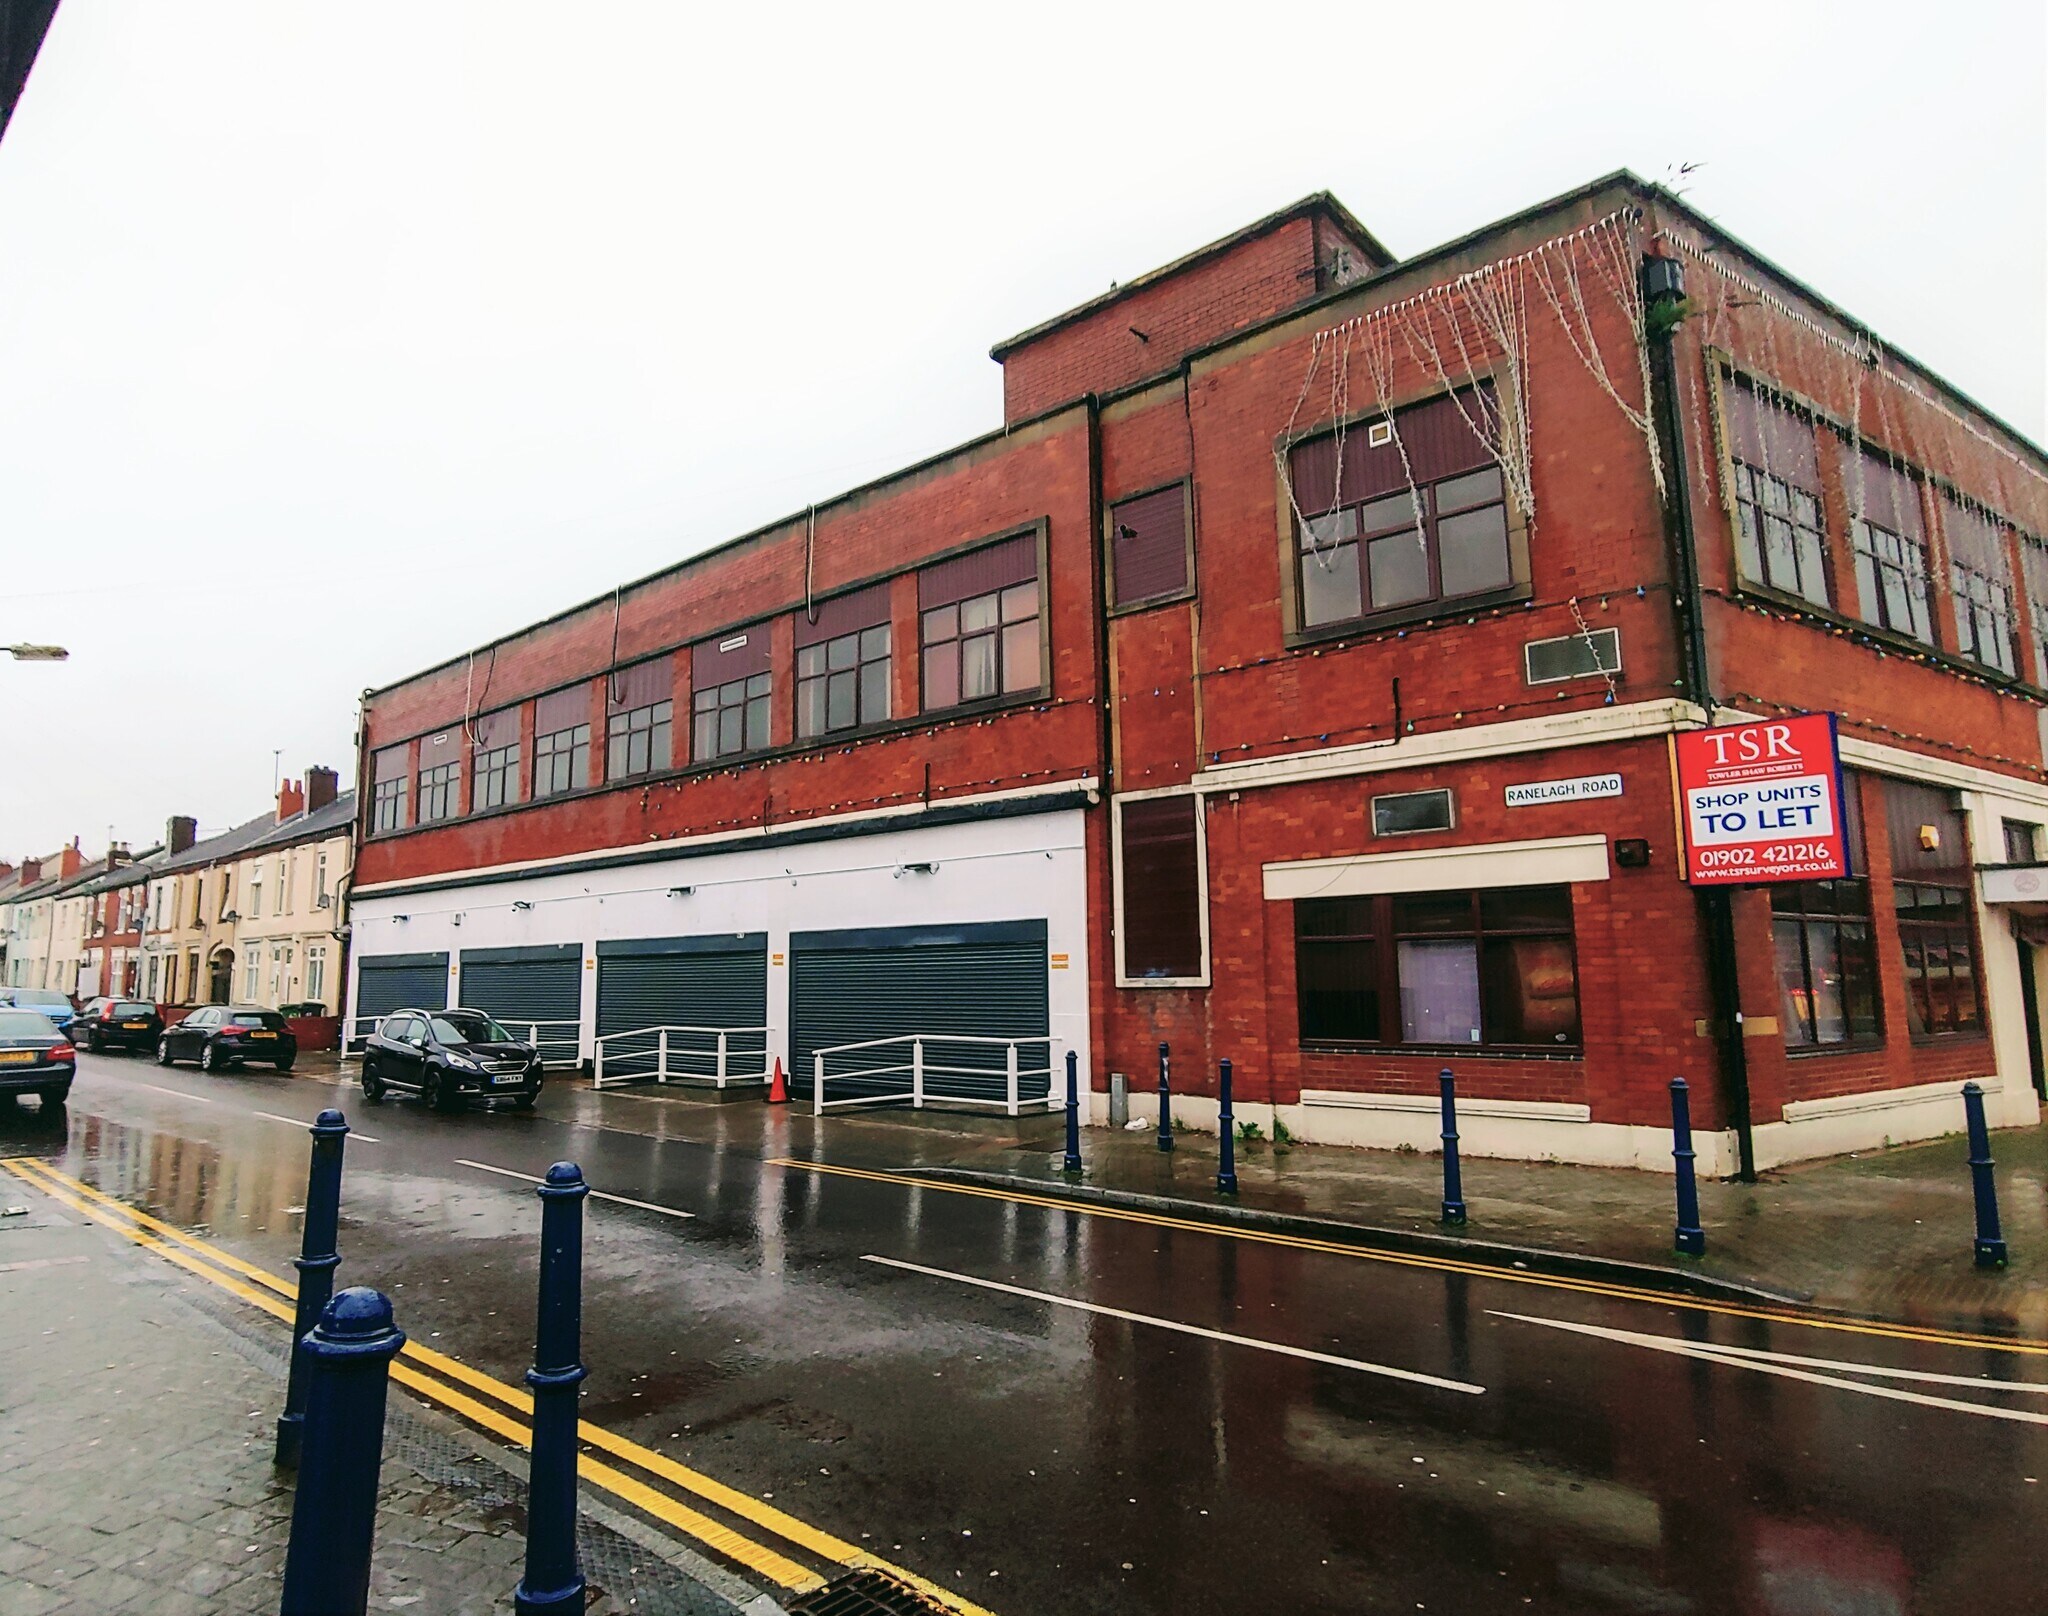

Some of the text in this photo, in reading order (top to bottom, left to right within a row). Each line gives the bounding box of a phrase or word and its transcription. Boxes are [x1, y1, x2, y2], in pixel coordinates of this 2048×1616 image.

[1704, 725, 1801, 764] TSR
[1708, 763, 1804, 781] TOWLER SHAW ROBERTS
[1508, 779, 1619, 801] RANELAGH ROAD
[1696, 785, 1821, 809] SHOP UNITS
[1700, 805, 1820, 833] TO LET
[1700, 842, 1830, 867] 01902 421216
[1695, 859, 1838, 878] www.tsrsurveyors.co.uk
